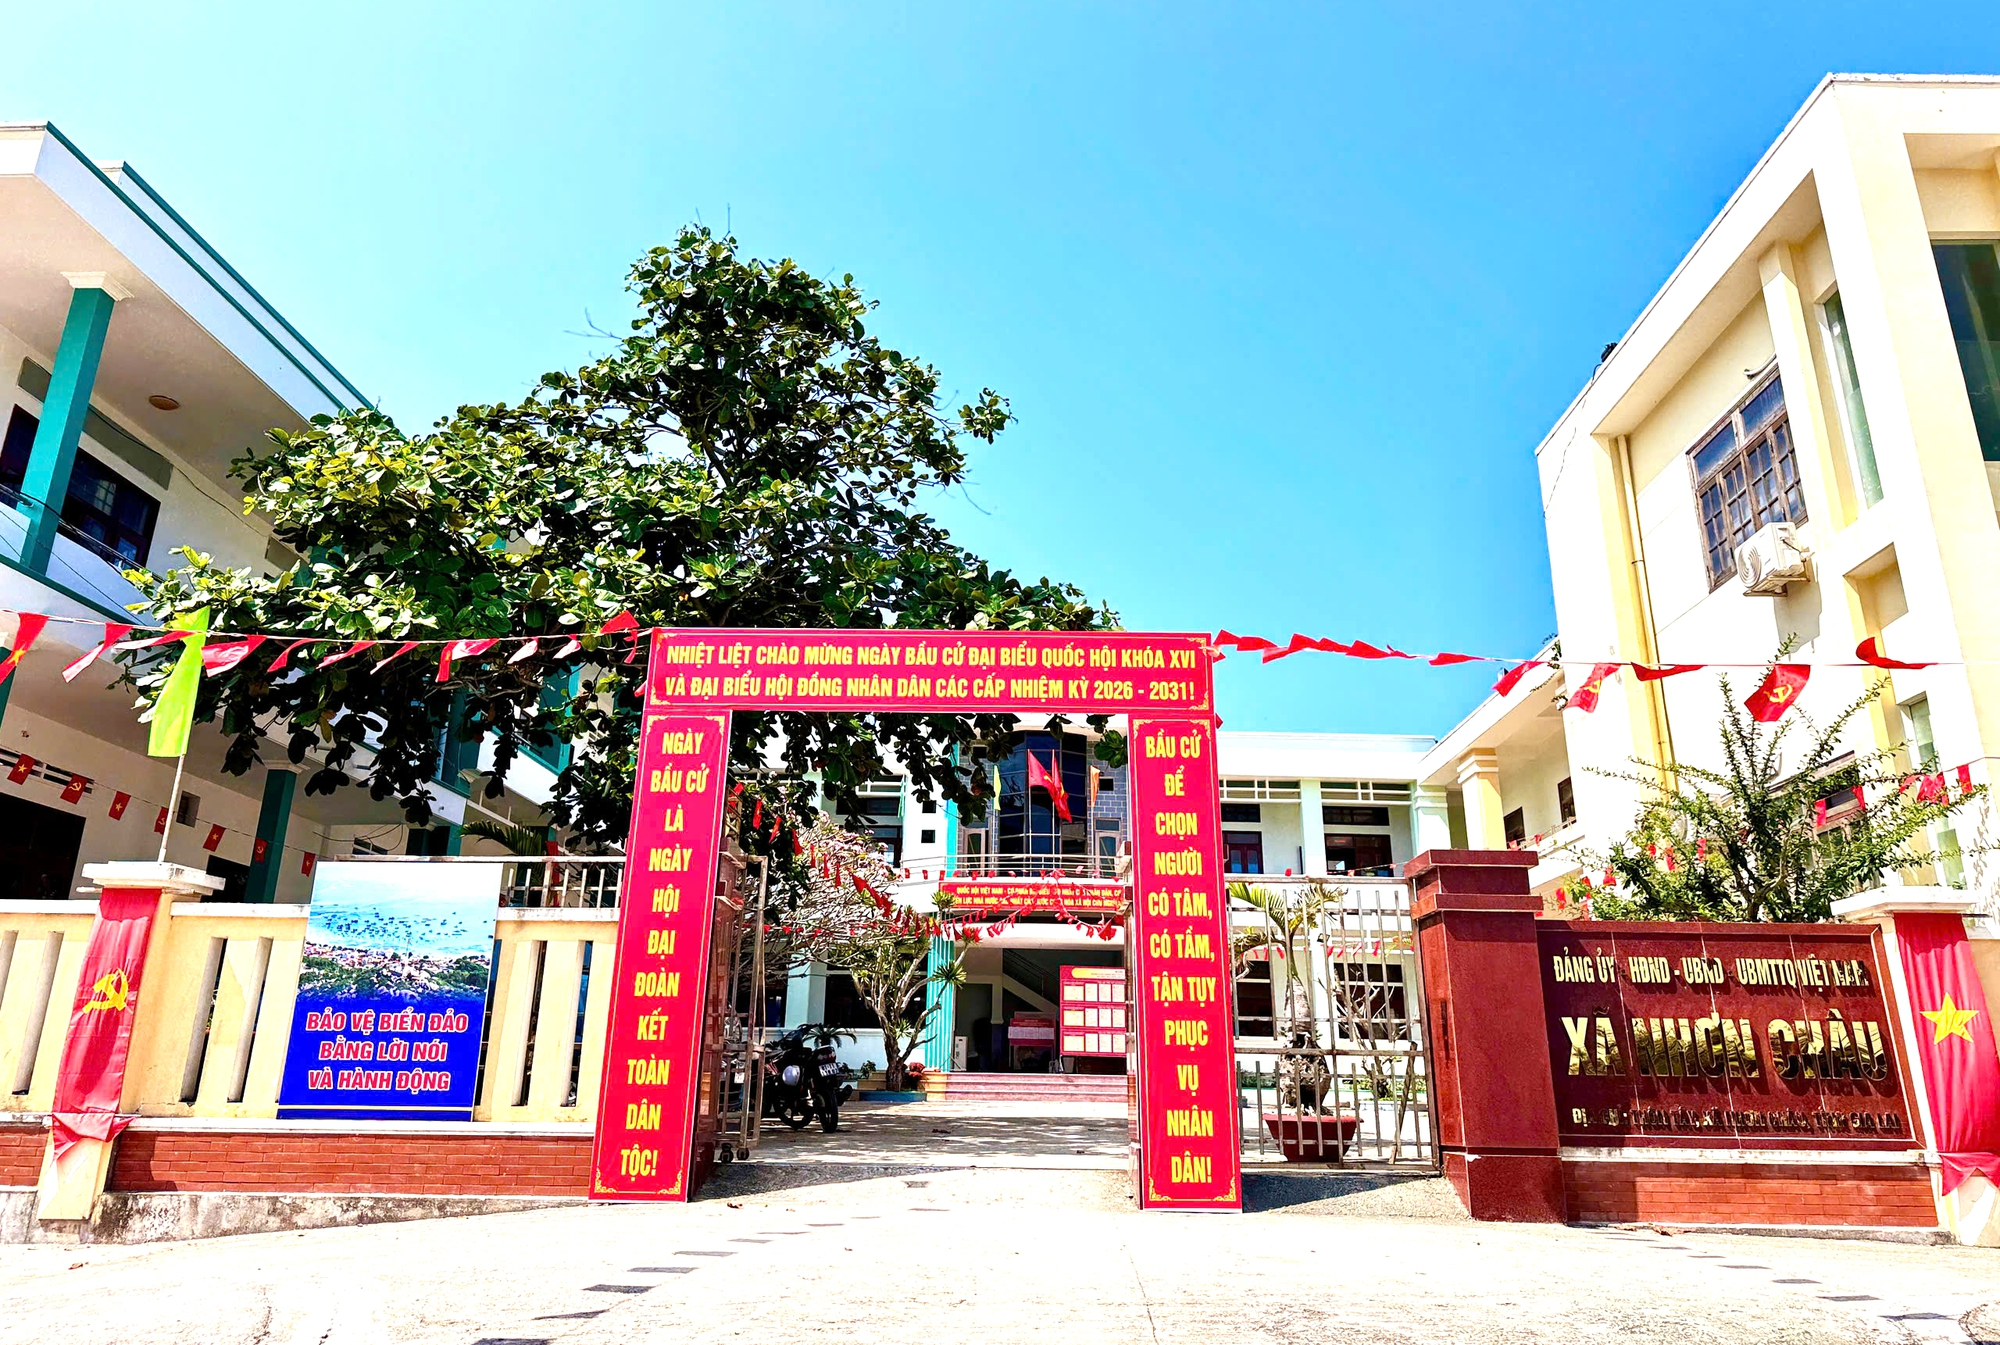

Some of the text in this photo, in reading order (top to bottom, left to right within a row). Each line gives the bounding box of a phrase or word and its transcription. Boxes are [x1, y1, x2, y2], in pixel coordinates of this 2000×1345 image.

[666, 640, 1196, 671] NHIỆT LIỆT CHÀO MỪNG NGÀY BẦU CỬ ĐẠI BIỂU QUỐC HỘI KHÓA XVI
[665, 673, 686, 696] VÀ
[690, 677, 718, 700] ĐẠI
[723, 670, 760, 696] BIỂU
[765, 674, 793, 700] HỘI
[797, 672, 842, 697] ĐỒNG
[847, 674, 892, 697] NHÂN
[897, 674, 931, 697] DÂN
[935, 672, 970, 698] CÁC
[973, 672, 1005, 698] CẤP
[1010, 676, 1064, 702] NHIỆM
[1068, 677, 1090, 698] KỲ
[1094, 681, 1134, 699] 2026
[1149, 681, 1195, 700] 2031!
[662, 728, 704, 754] NGÀY
[1145, 728, 1202, 758] BẦU CỬ
[650, 763, 710, 793] BẦU CỬ
[1164, 765, 1185, 796] ĐỂ
[664, 804, 684, 832] LÀ
[1155, 812, 1198, 840] CHỌN
[648, 844, 692, 872] NGÀY
[1154, 847, 1202, 876] NGƯỜI
[652, 884, 680, 918] HỘI
[1148, 887, 1213, 920] CÓ TÂM,
[648, 930, 676, 959] ĐẠI
[1150, 926, 1215, 962] CÓ TẦM,
[634, 967, 680, 997] ĐOÀN
[1553, 946, 1595, 983] ĐẢNG
[1596, 947, 1615, 983] ỦY
[1628, 956, 1670, 983] HĐND
[1681, 957, 1724, 984] UBND
[1735, 958, 1797, 988] UBMTTQ
[1797, 953, 1830, 992] VIỆT
[1830, 960, 1869, 986] NAM
[1151, 971, 1216, 1007] TẬN TỤY
[306, 1007, 469, 1035] BẢO VỆ BIỂN ĐẢO
[637, 1007, 669, 1040] KẾT
[1164, 1020, 1209, 1051] PHỤC
[319, 1035, 448, 1061] BẰNG LỜI NÓI
[1560, 1006, 1888, 1081] XÃ NHƠN CHÂU
[308, 1067, 451, 1095] VÀ HÀNH ĐỘNG
[627, 1054, 670, 1085] TOÀN
[1177, 1064, 1199, 1096] VỤ
[625, 1099, 661, 1130] DÂN
[1167, 1105, 1214, 1137] NHÂN
[620, 1144, 658, 1181] TỘC!
[1171, 1151, 1212, 1183] DÂN!
